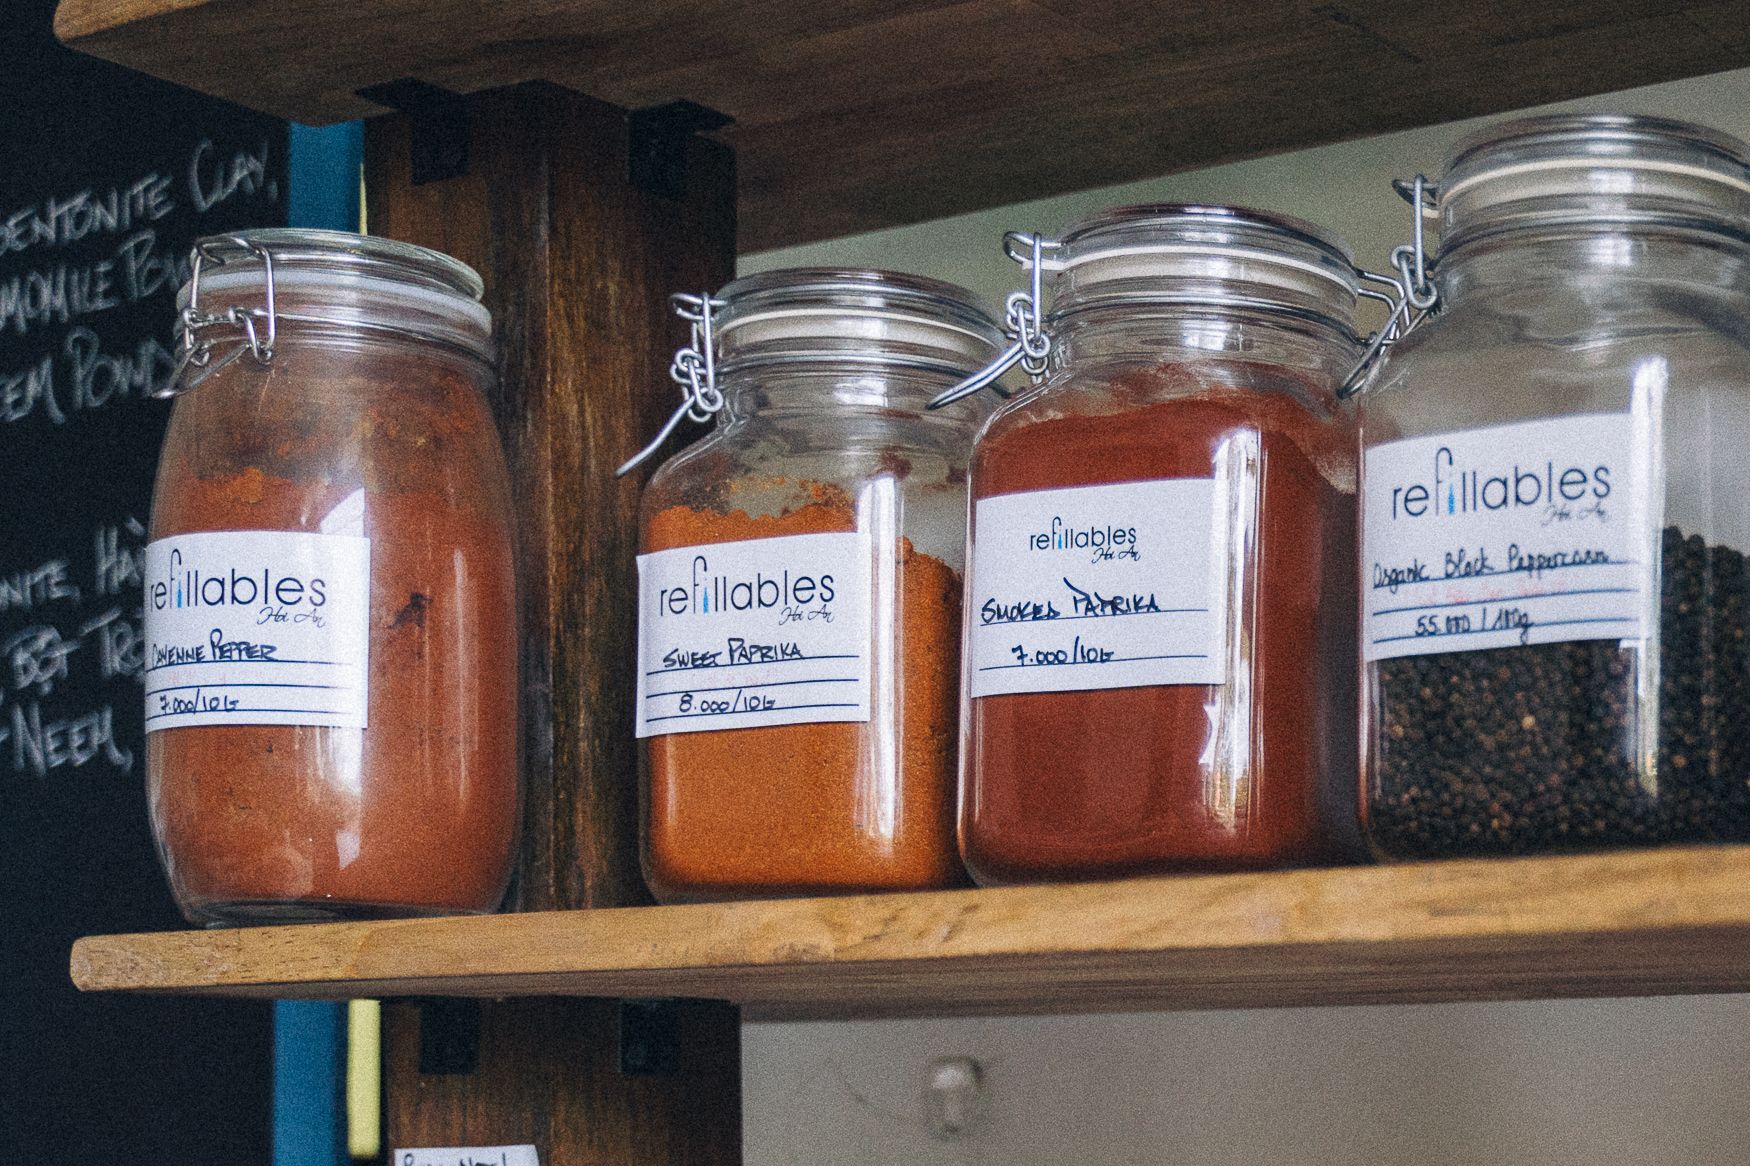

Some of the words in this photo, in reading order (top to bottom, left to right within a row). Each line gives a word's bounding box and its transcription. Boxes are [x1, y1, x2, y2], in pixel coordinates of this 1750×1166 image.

[1393, 447, 1611, 520] refillables
[1030, 516, 1137, 551] refillables
[151, 548, 326, 611] refillables
[660, 556, 835, 616] refillables
[981, 598, 1060, 624] SMOKED
[209, 628, 278, 661] PEPPER
[663, 648, 722, 668] SWEET
[727, 637, 804, 665] PAPRIKA
